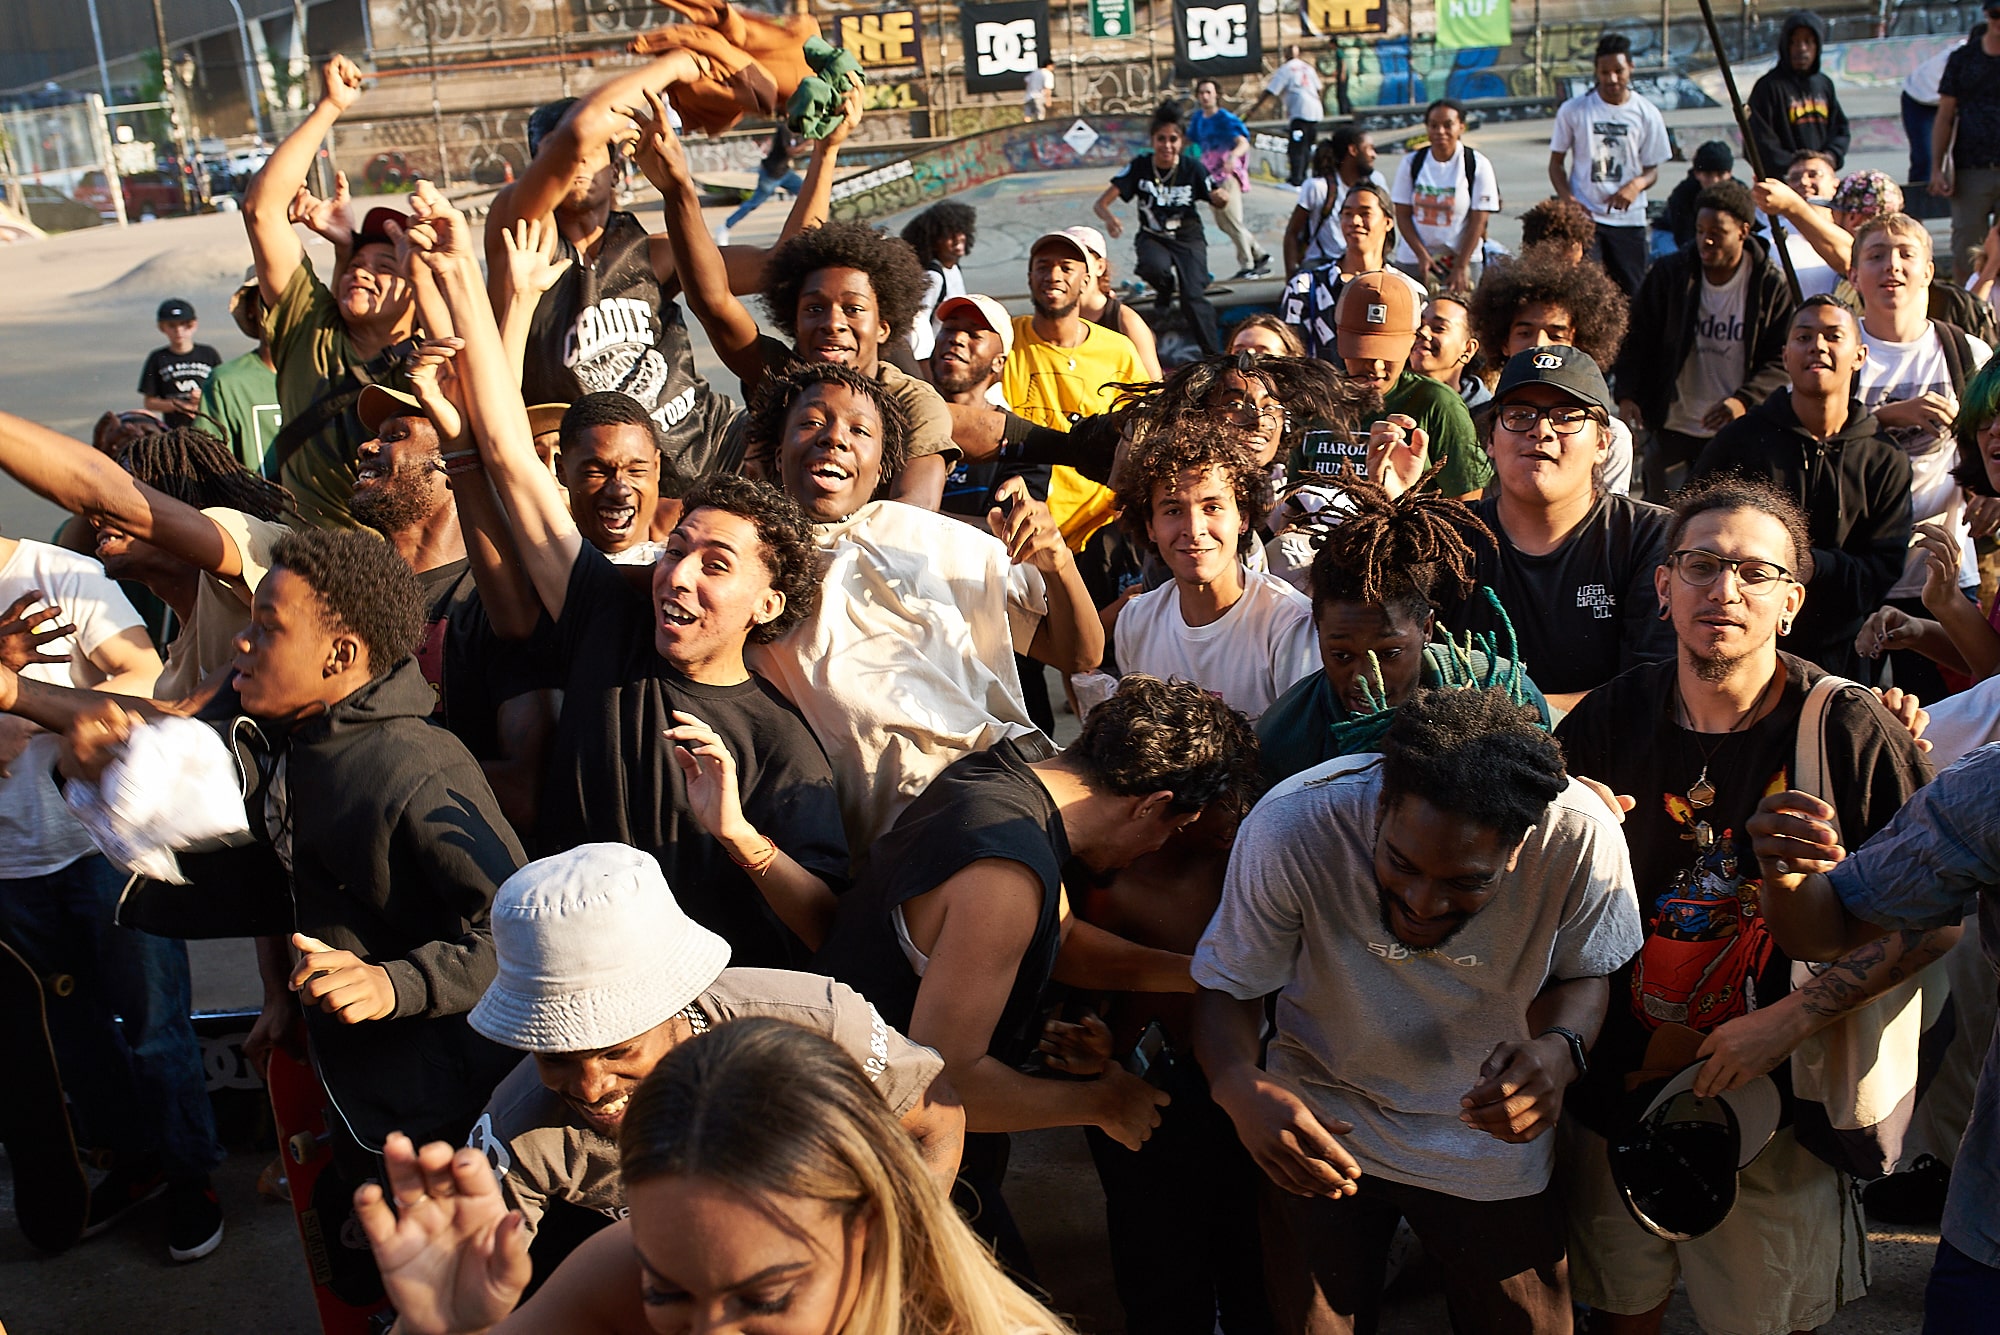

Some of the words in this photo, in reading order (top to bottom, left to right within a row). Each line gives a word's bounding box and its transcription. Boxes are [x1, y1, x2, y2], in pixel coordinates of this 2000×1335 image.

[975, 18, 1038, 76] DC
[1186, 4, 1248, 61] DC
[1317, 441, 1369, 456] HAROL
